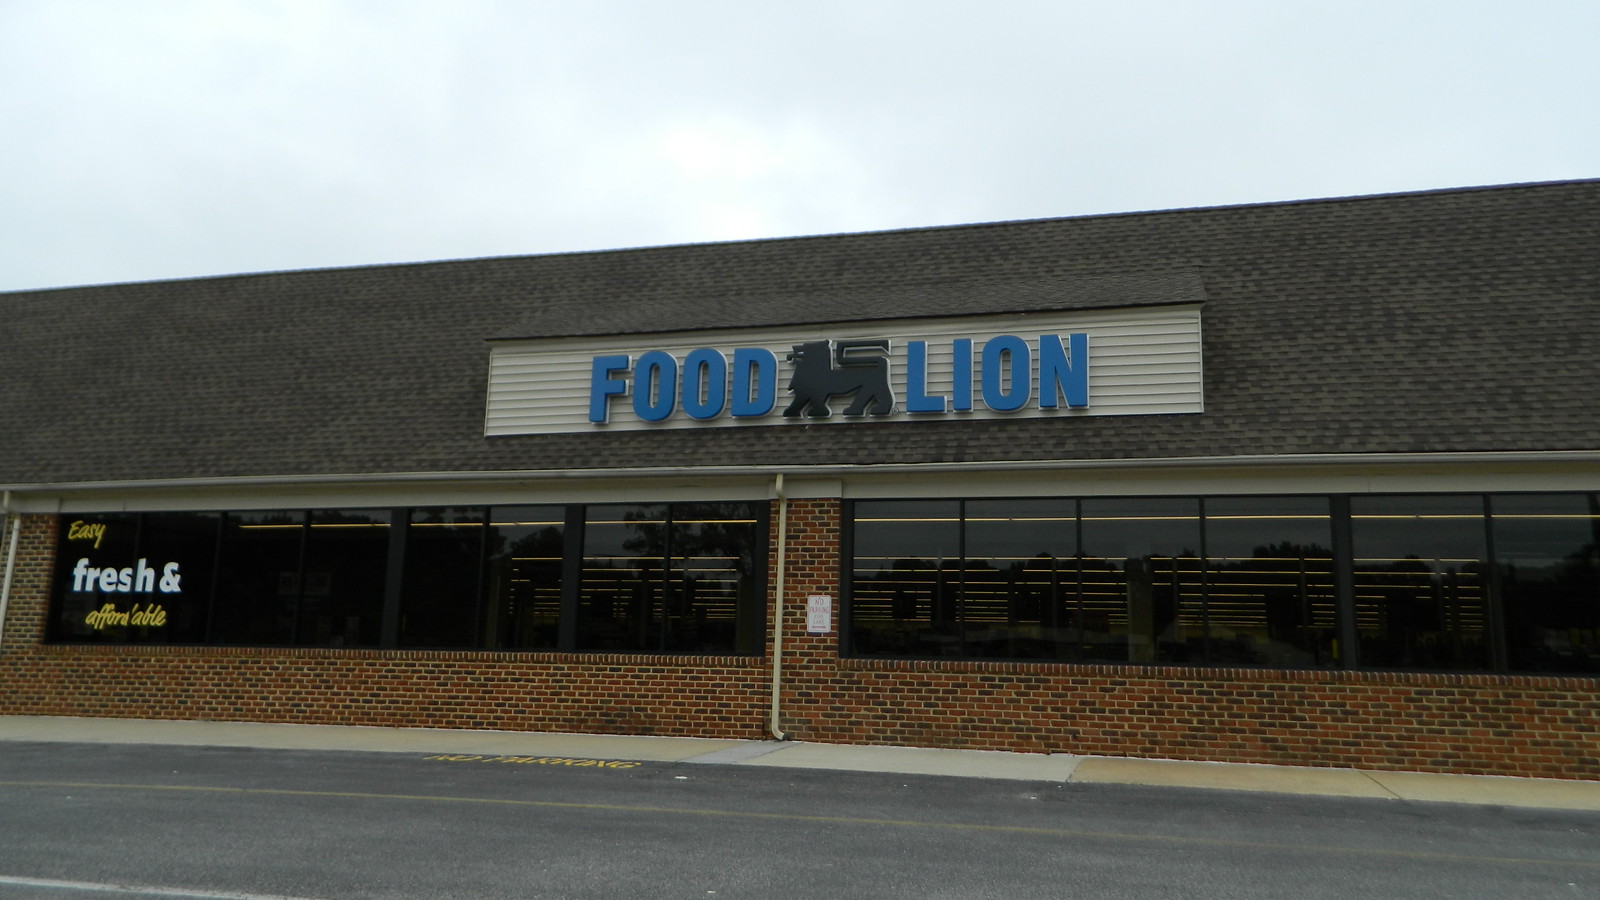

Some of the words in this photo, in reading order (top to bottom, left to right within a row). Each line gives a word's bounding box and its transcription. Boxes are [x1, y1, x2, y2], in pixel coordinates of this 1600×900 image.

[589, 348, 778, 423] FOOD
[906, 333, 1089, 414] LION
[68, 520, 105, 548] Easy
[73, 557, 155, 592] fresh
[159, 561, 181, 592] &
[482, 756, 642, 768] PARKING
